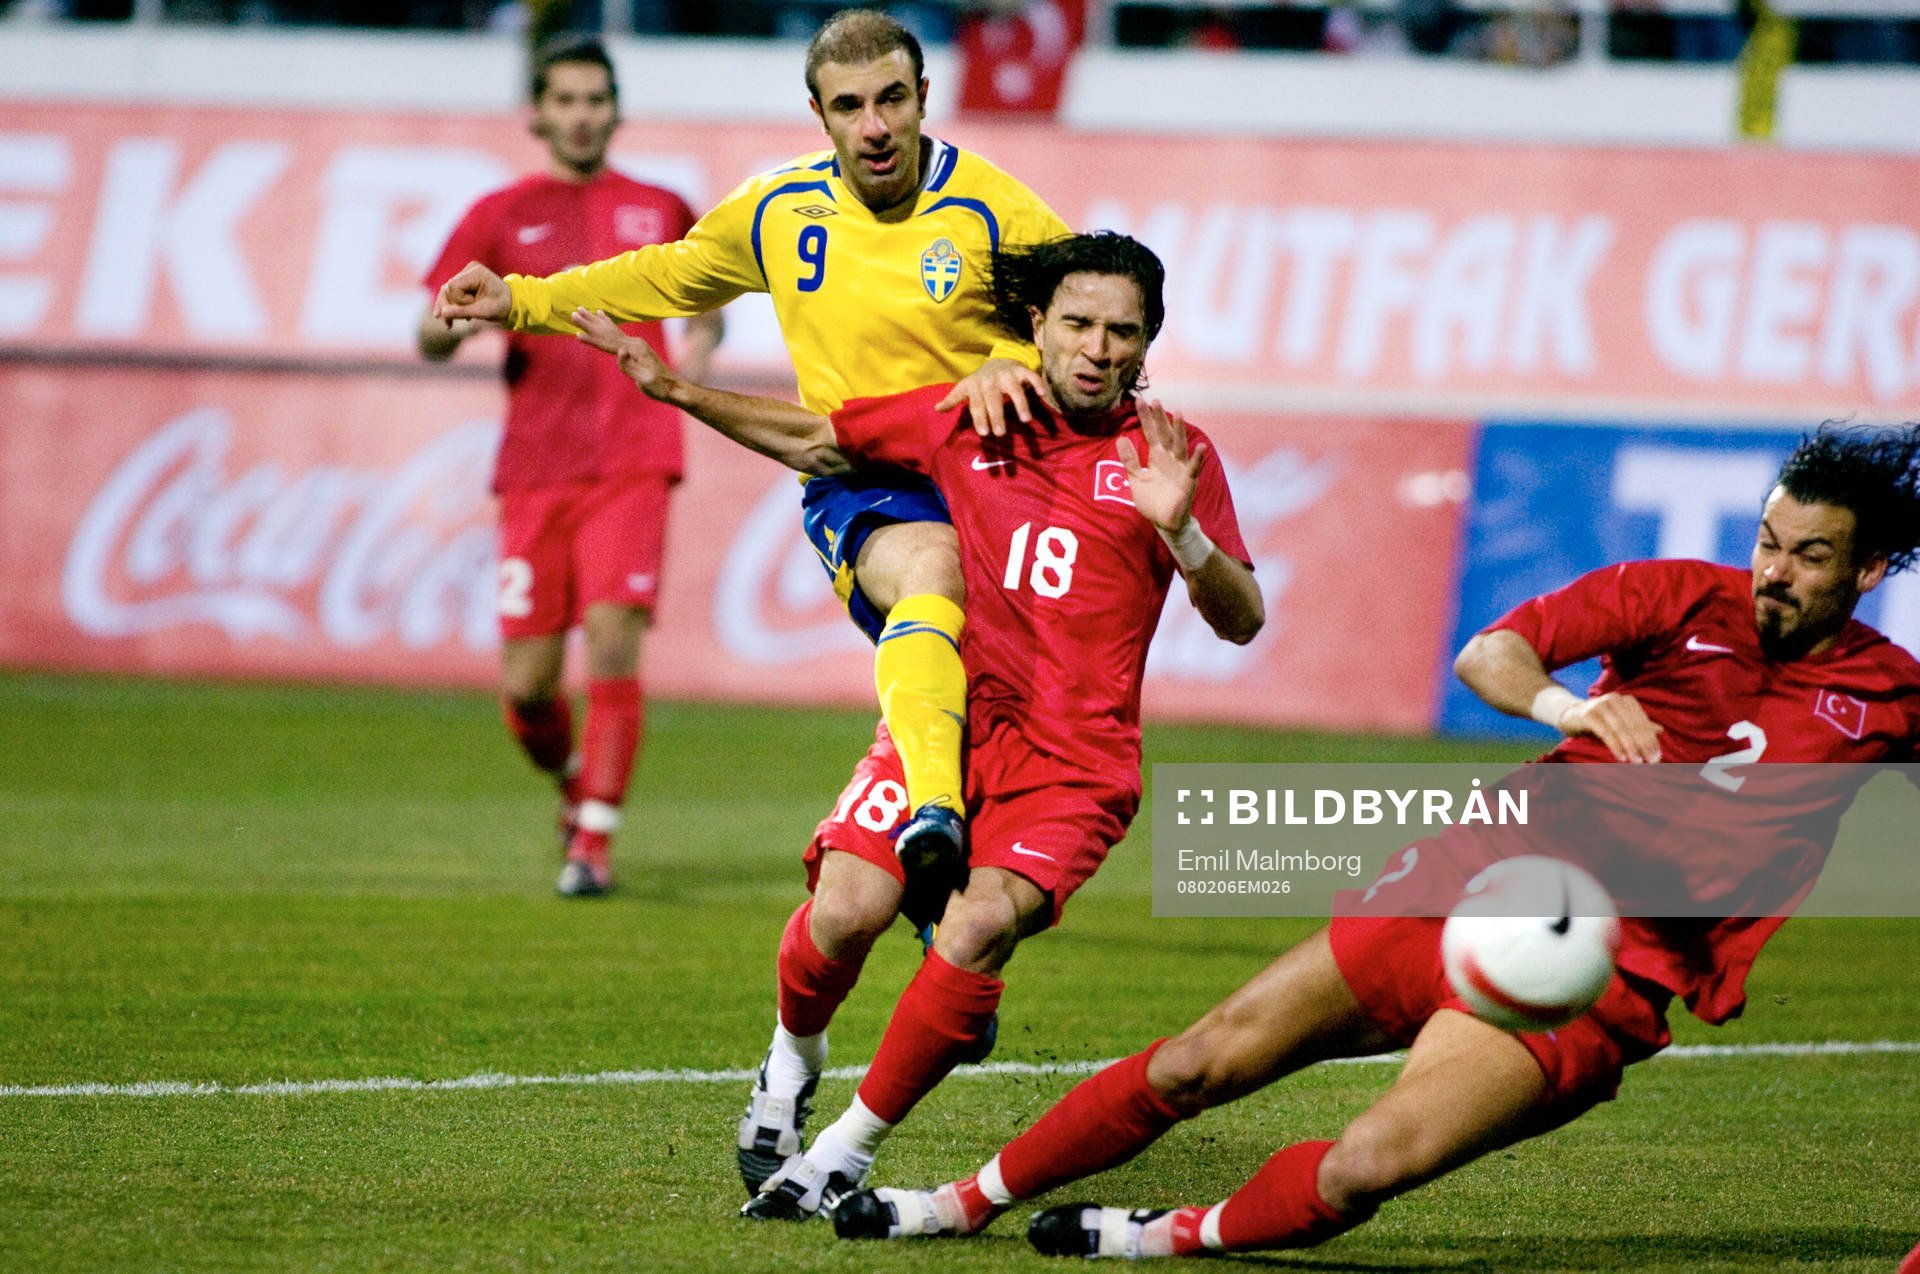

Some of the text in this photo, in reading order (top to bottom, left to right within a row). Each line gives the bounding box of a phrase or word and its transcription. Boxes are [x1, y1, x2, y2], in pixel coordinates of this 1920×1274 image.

[797, 224, 827, 292] 9
[1643, 215, 1920, 397] GER
[1003, 521, 1078, 599] 18
[1699, 719, 1767, 793] 2
[833, 775, 908, 833] 18
